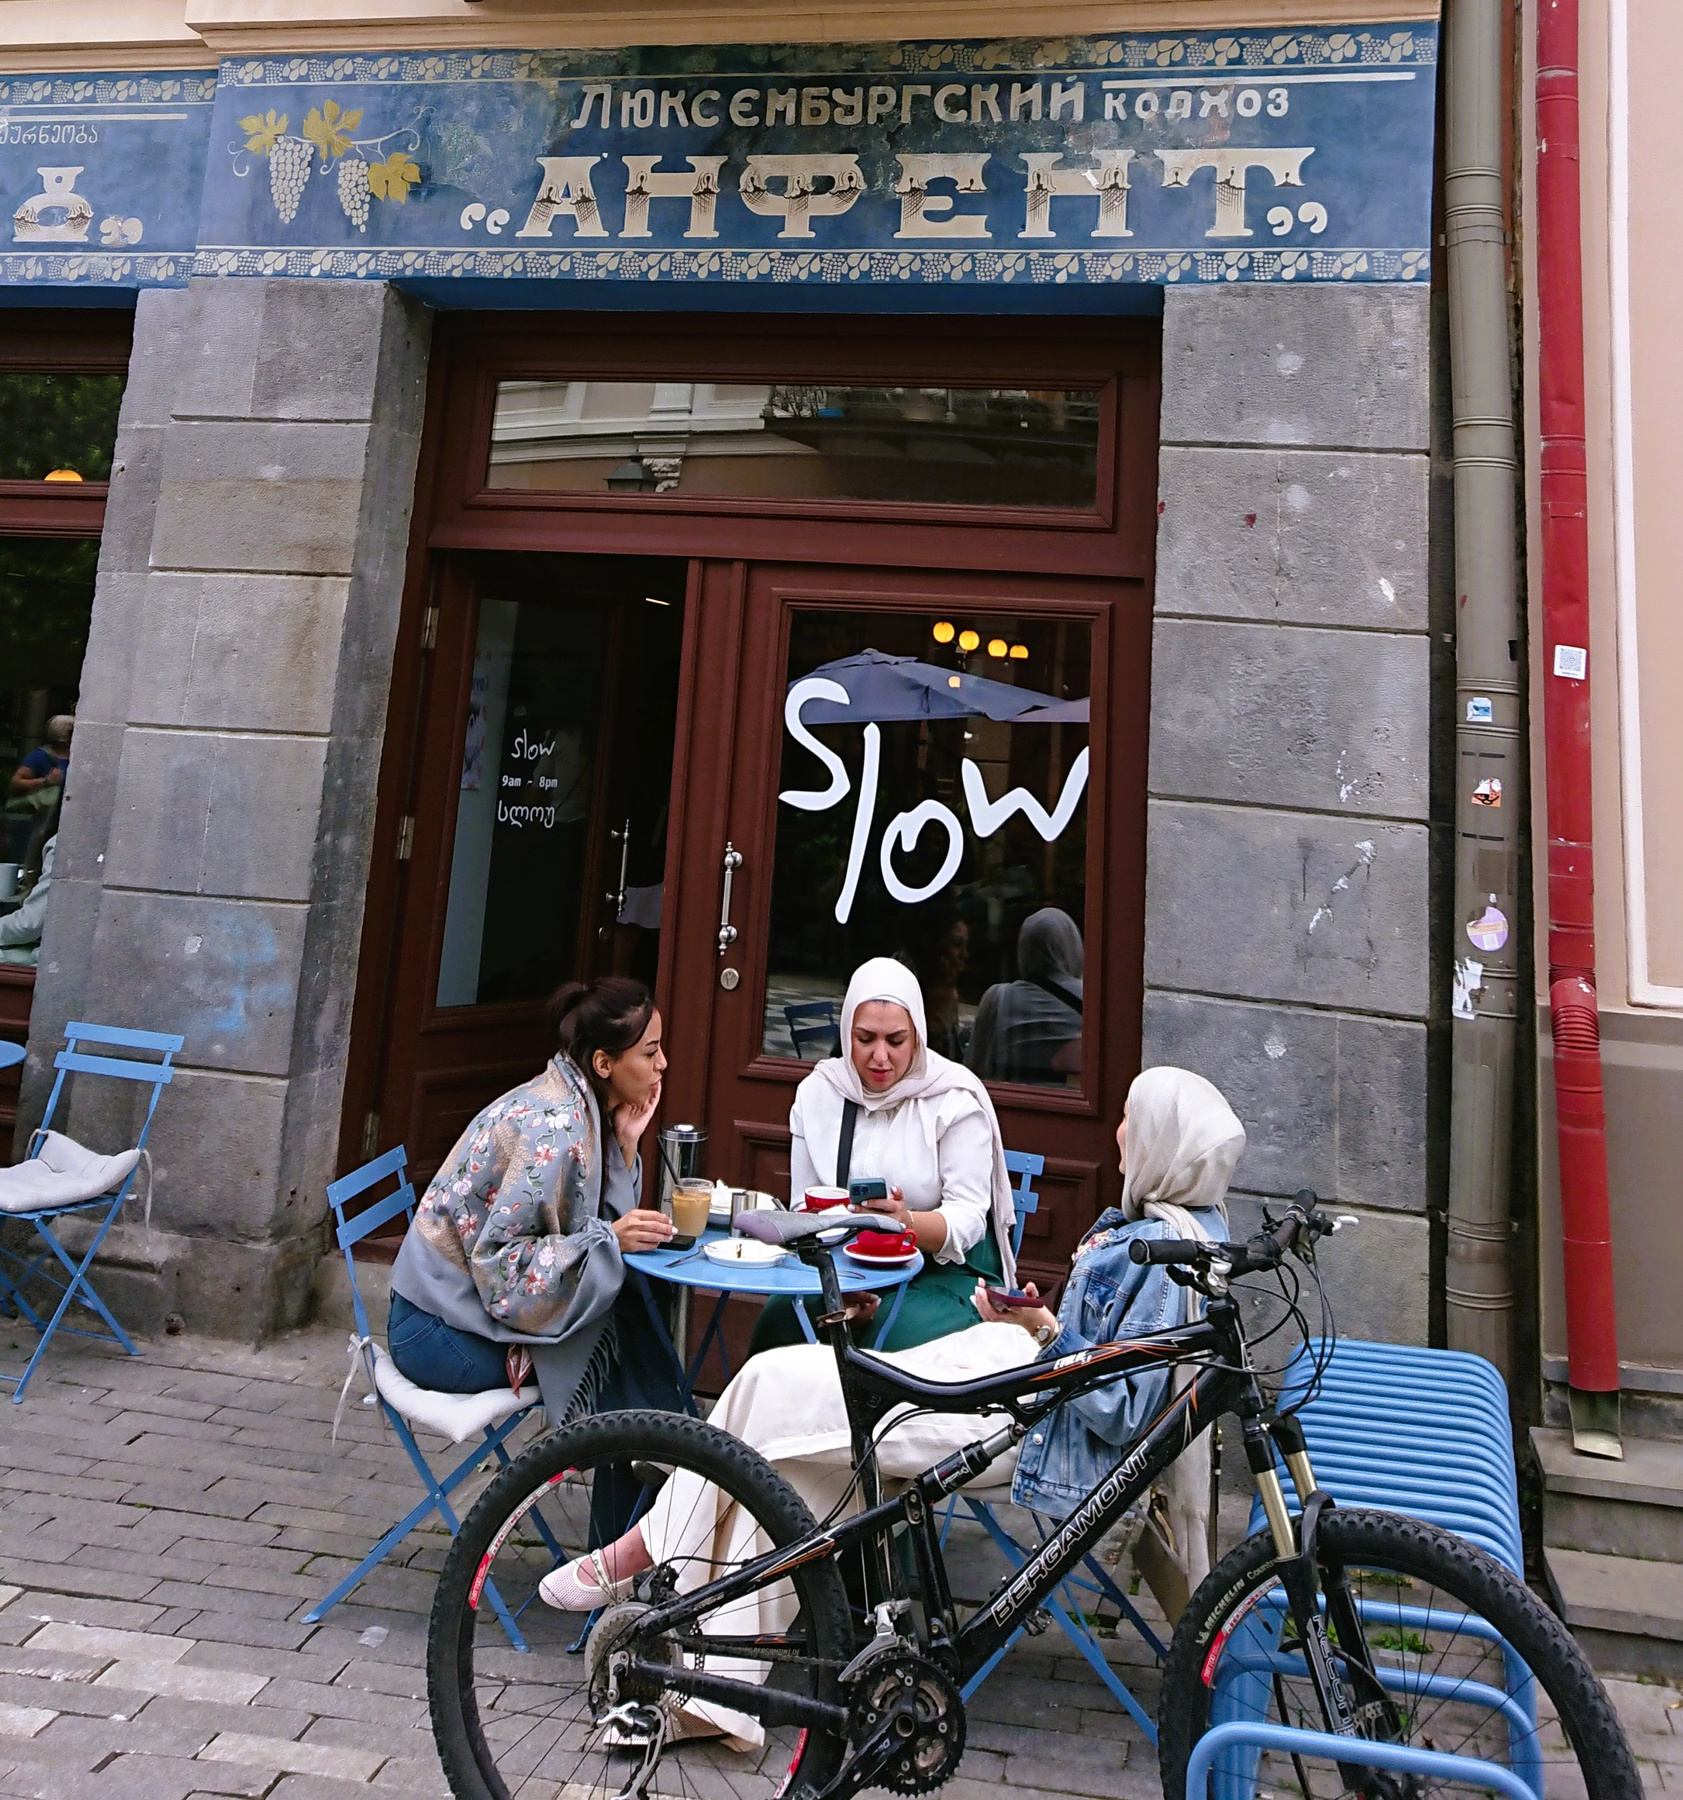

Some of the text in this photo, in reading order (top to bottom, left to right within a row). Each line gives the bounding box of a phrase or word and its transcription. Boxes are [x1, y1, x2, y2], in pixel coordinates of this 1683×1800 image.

[502, 775, 521, 787] 9am
[539, 776, 558, 790] 8pm
[778, 677, 1089, 925] Slow
[498, 800, 555, 828] სლოუ
[990, 1440, 1149, 1628] BERGAMONT
[1204, 1578, 1246, 1630] MICHELIN
